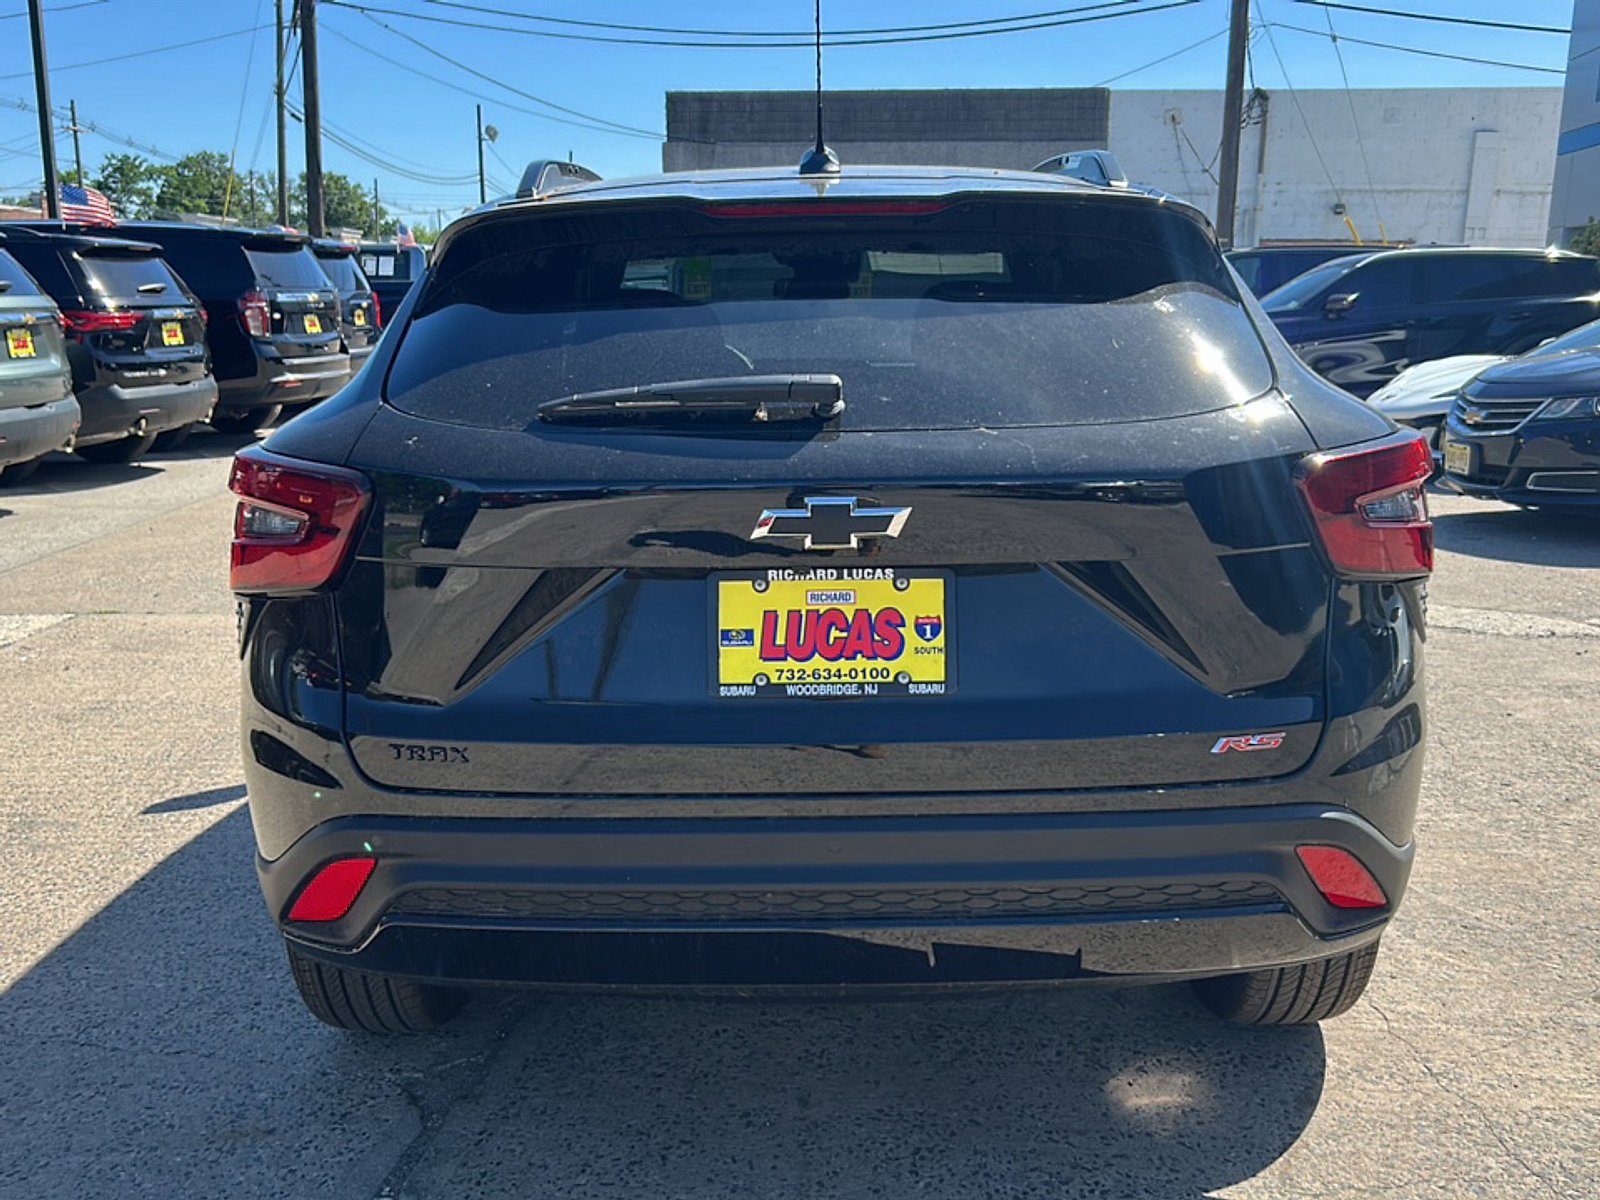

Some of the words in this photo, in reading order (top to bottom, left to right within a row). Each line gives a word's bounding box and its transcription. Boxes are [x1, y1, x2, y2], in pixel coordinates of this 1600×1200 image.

[844, 568, 894, 580] LUCAS
[810, 593, 851, 602] RICHARD
[759, 607, 906, 662] LUCAS
[923, 624, 933, 639] 1
[775, 667, 890, 680] 732-634-0100
[720, 685, 756, 696] SUBARU
[864, 683, 878, 694] NJ
[908, 683, 945, 694] SUBARU
[1210, 732, 1286, 753] RS
[388, 743, 470, 763] TRAX
